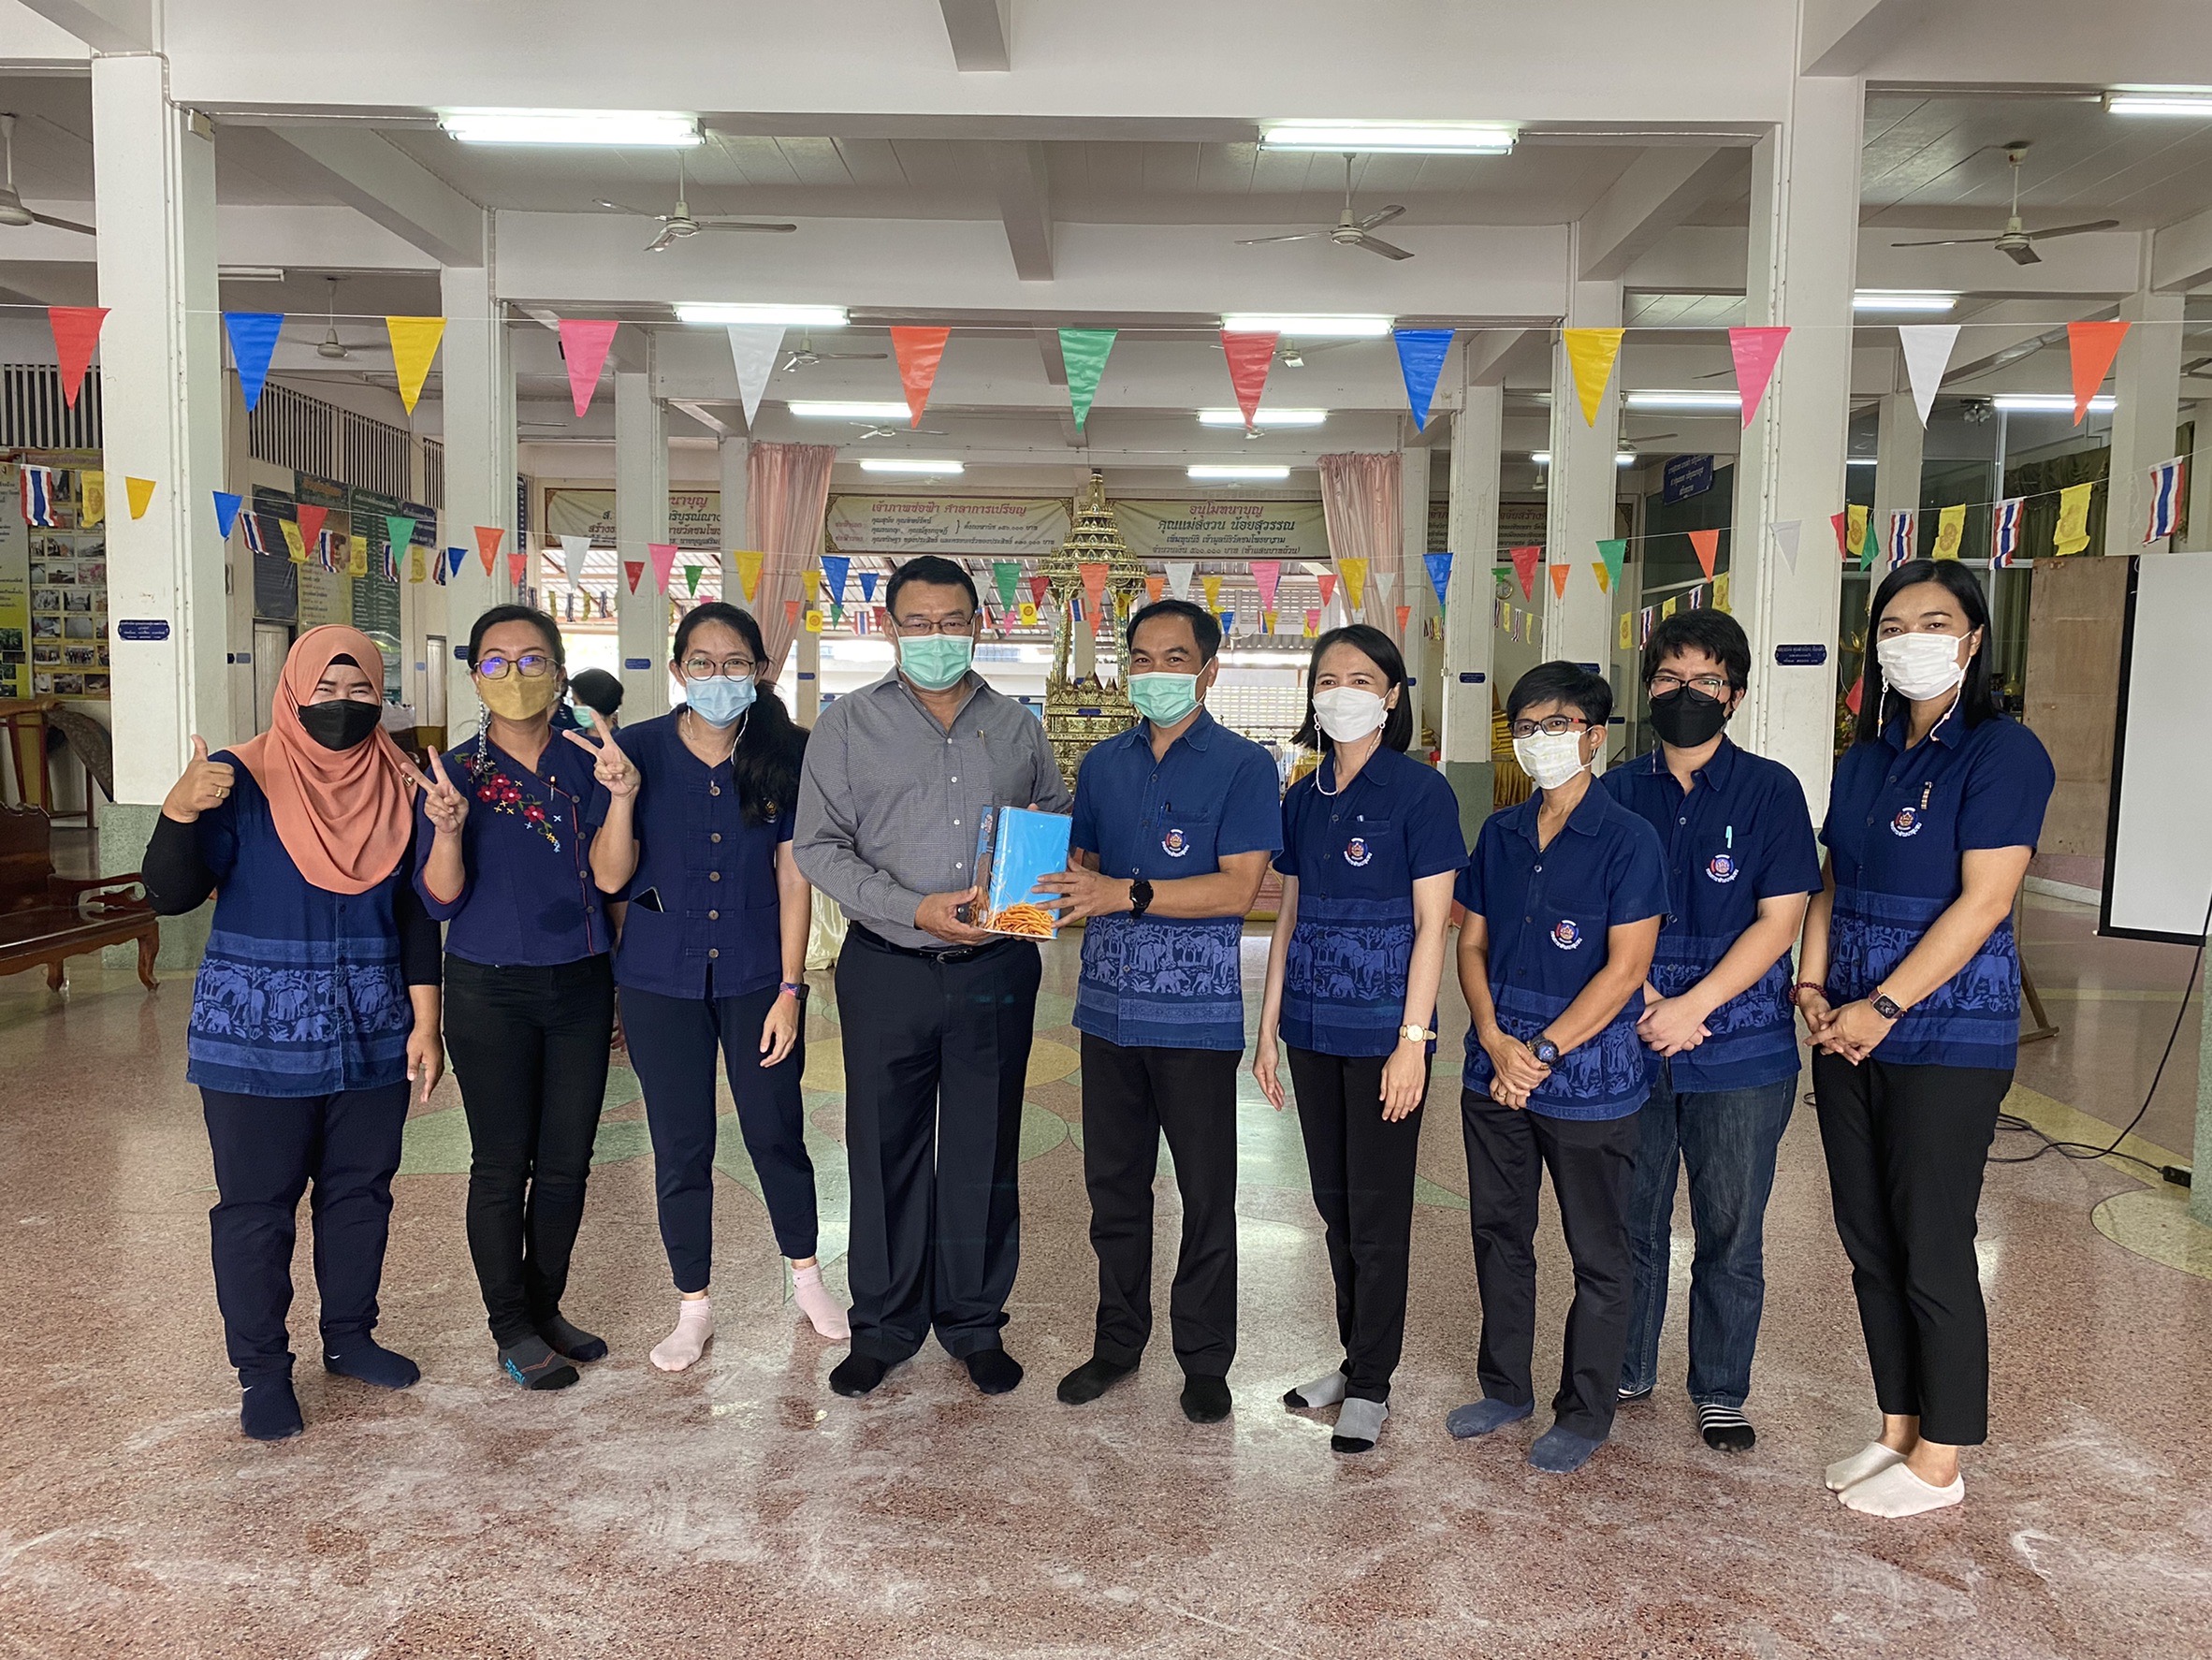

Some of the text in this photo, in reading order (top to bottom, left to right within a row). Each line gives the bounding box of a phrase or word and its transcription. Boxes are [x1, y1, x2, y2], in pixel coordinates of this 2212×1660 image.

[669, 496, 708, 509] นาบุญ
[872, 501, 1026, 517] เจ้าภาพช่อฟ้า ศาลาการเปรียญ
[1189, 501, 1263, 517] อนุโมทนาบุญ
[669, 509, 720, 524] ริบูรณ์ณา
[1157, 517, 1295, 534] คุณแม่สงวน น้อยสุวรรณ
